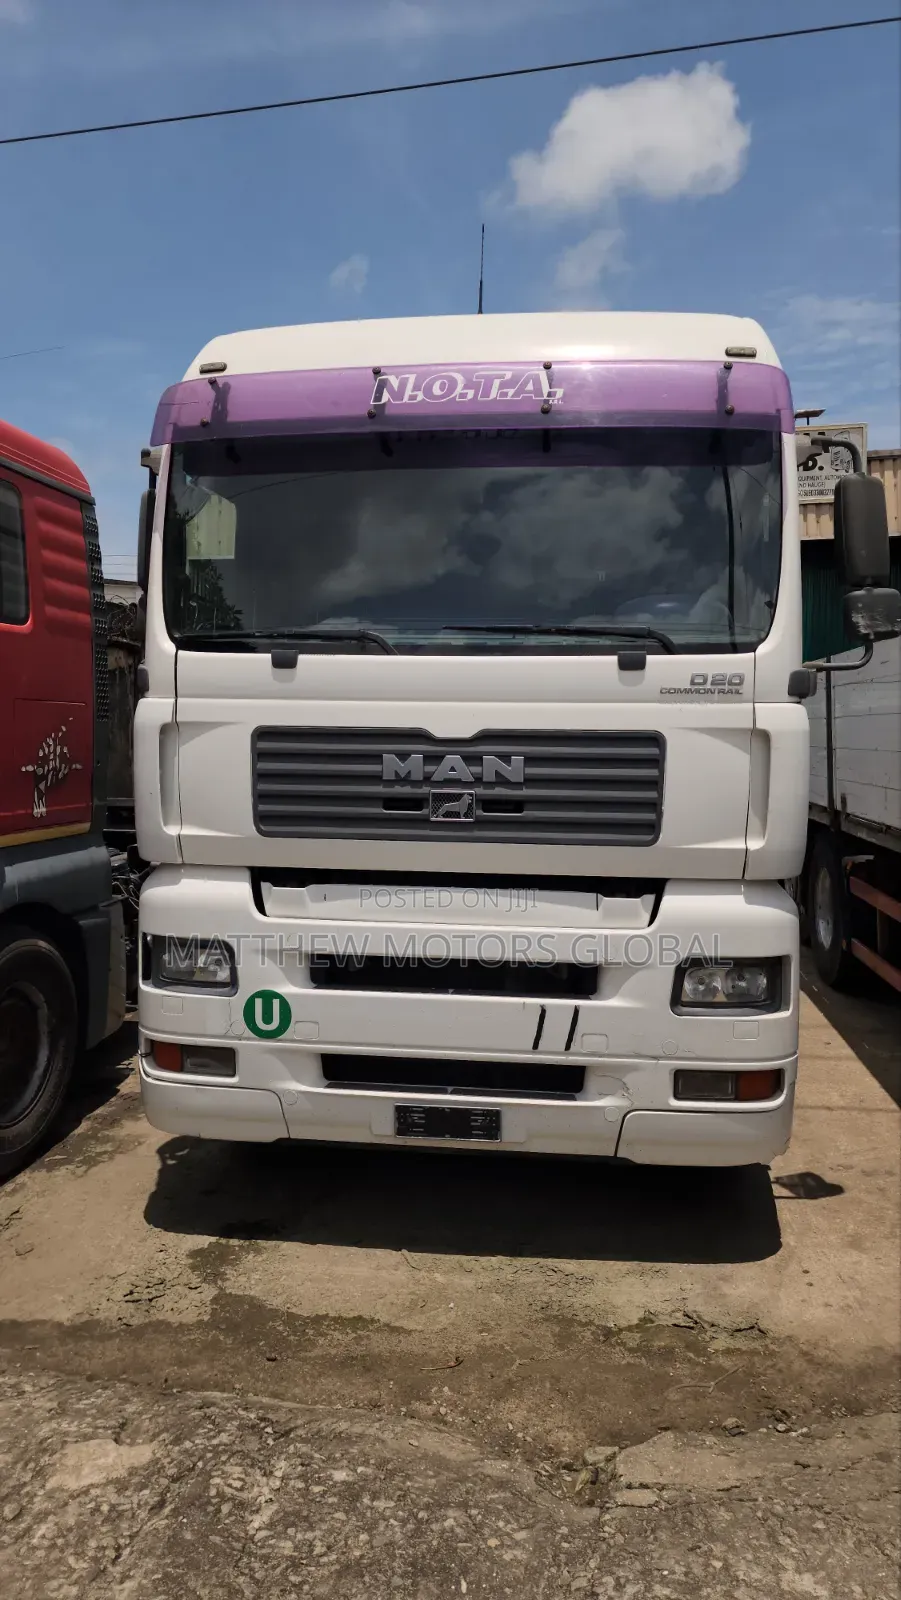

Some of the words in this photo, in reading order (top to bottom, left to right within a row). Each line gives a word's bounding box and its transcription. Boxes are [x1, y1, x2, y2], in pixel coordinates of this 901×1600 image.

[710, 673, 745, 686] 20
[659, 687, 716, 695] COMMON
[717, 687, 743, 695] RAIL
[382, 753, 525, 783] MAN
[254, 997, 280, 1031] U
